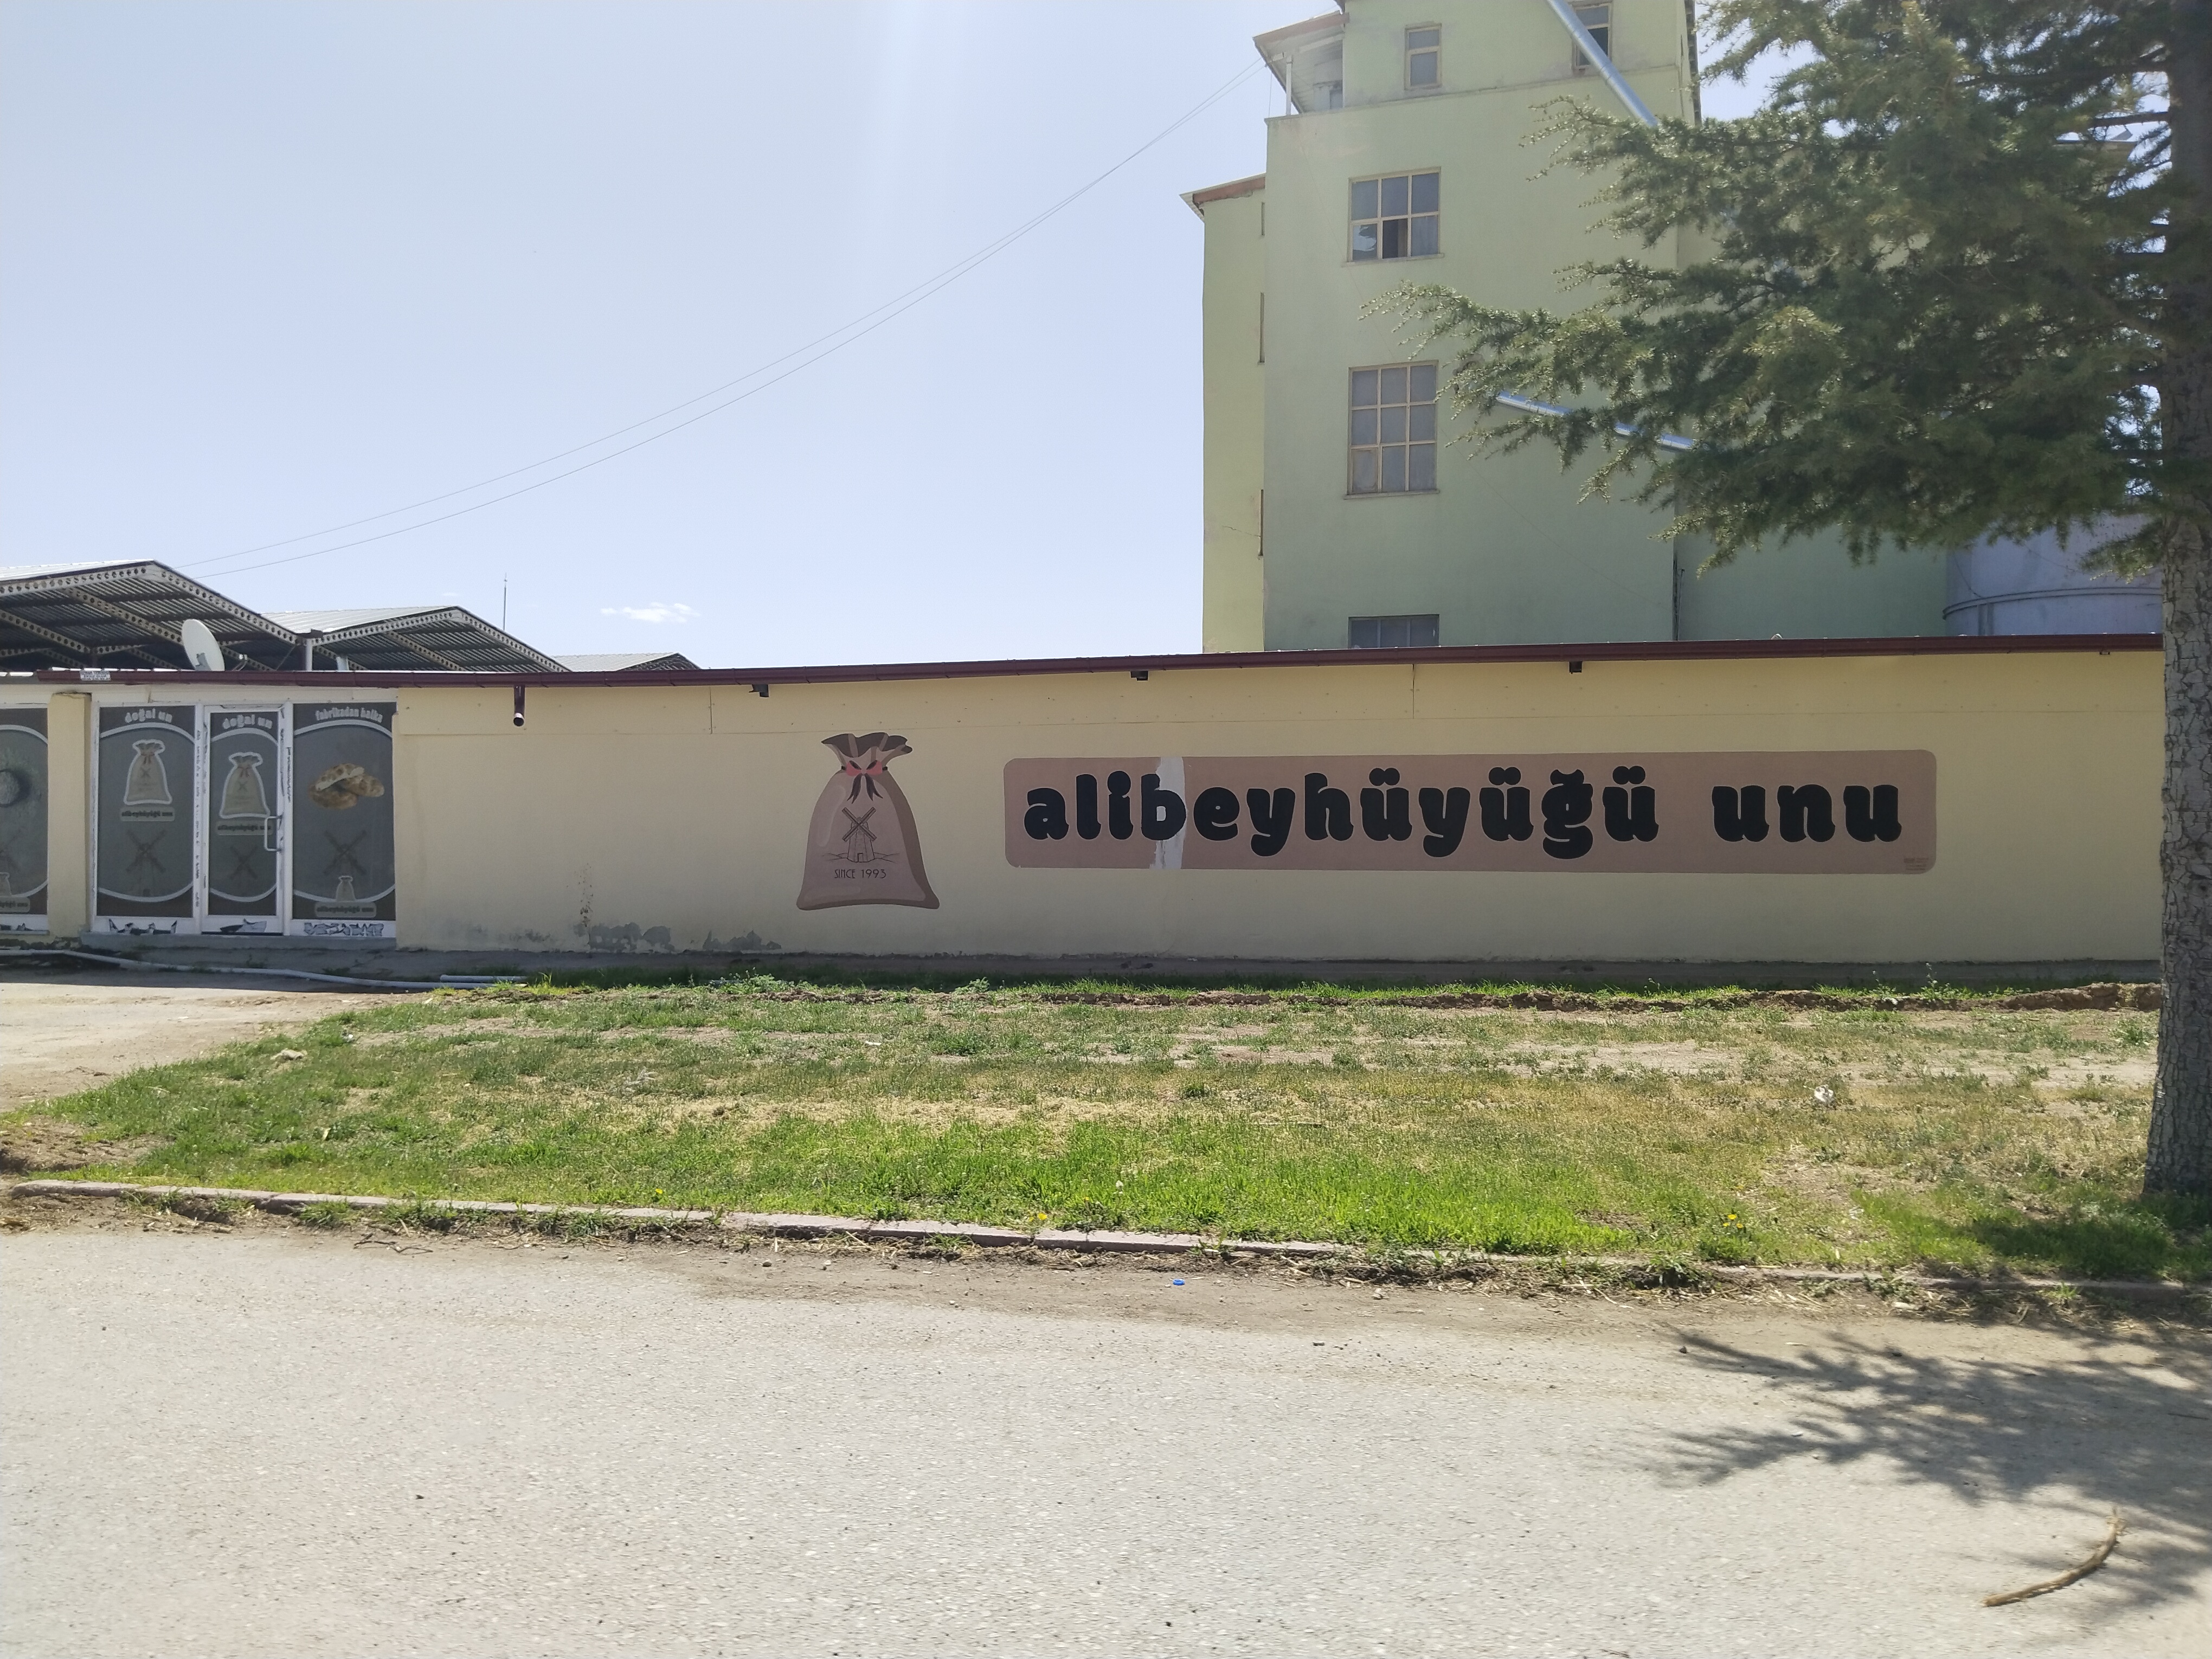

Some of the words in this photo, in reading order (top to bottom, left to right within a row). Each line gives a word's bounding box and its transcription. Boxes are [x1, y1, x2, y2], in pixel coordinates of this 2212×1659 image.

[1023, 765, 1660, 860] alibeyhüyüğü
[1711, 783, 1903, 843] unu
[834, 869, 856, 879] SINCE
[861, 869, 886, 879] 1993
